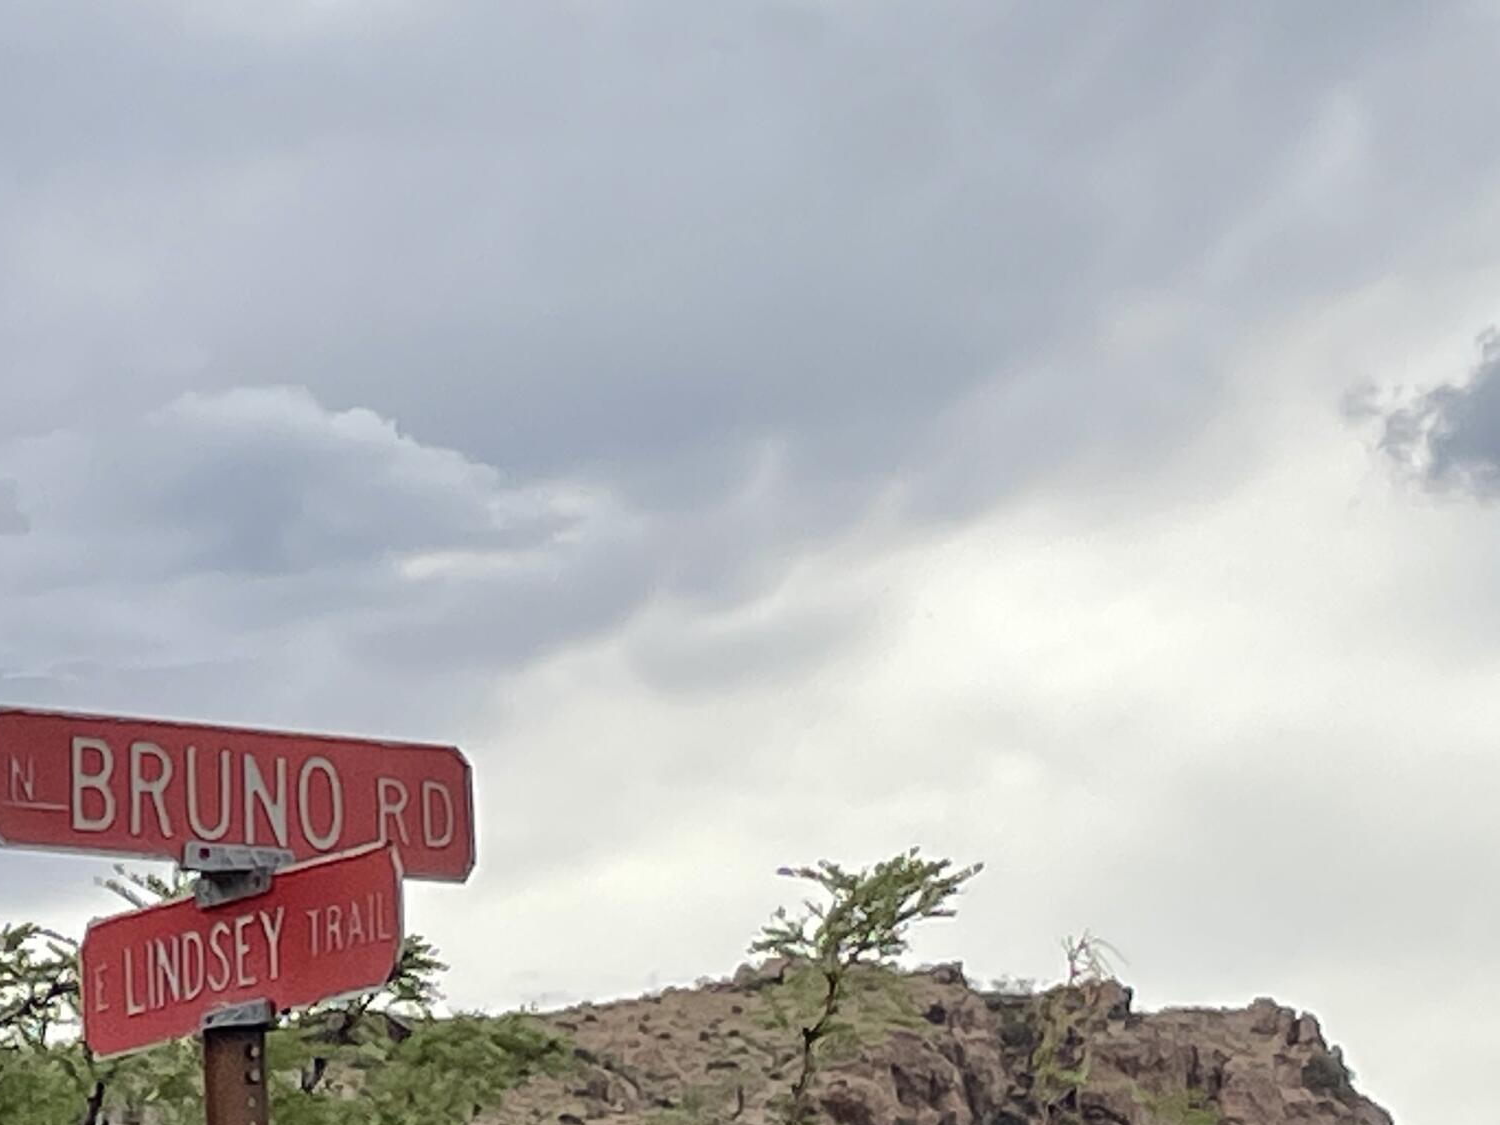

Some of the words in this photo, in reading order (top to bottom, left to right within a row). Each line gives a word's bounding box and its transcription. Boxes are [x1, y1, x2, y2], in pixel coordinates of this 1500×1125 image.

[9, 755, 35, 802] N
[70, 736, 344, 852] BRUNO
[377, 777, 455, 849] RD
[93, 963, 110, 1013] E
[123, 906, 285, 1017] LINDSEY
[306, 892, 393, 957] TRAIL
